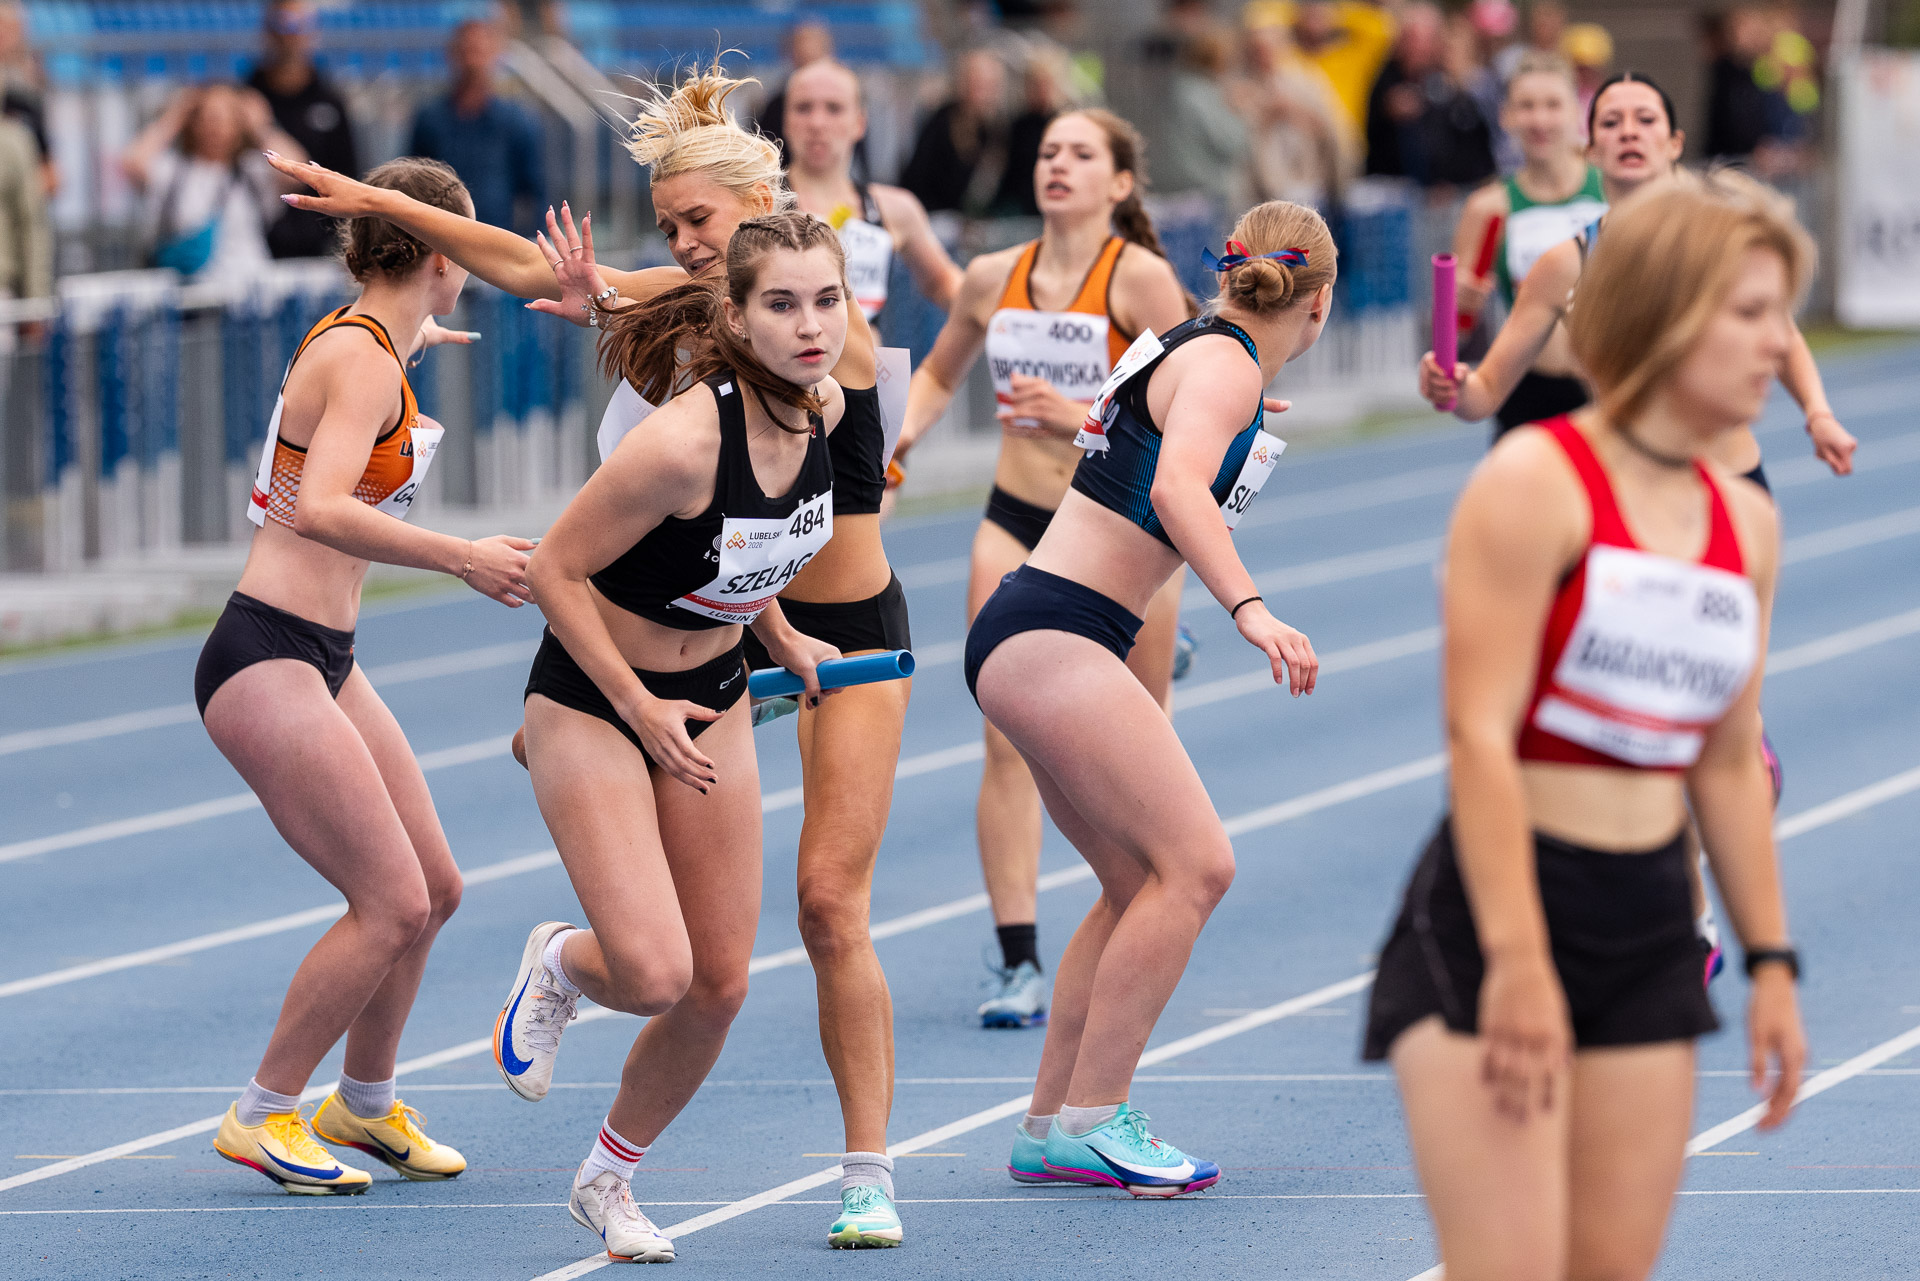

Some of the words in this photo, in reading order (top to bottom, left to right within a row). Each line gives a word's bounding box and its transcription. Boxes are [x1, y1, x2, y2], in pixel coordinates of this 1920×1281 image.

[1048, 322, 1094, 343] 400
[789, 503, 825, 539] 484
[748, 541, 763, 549] 2026
[707, 610, 751, 622] LUBLIN
